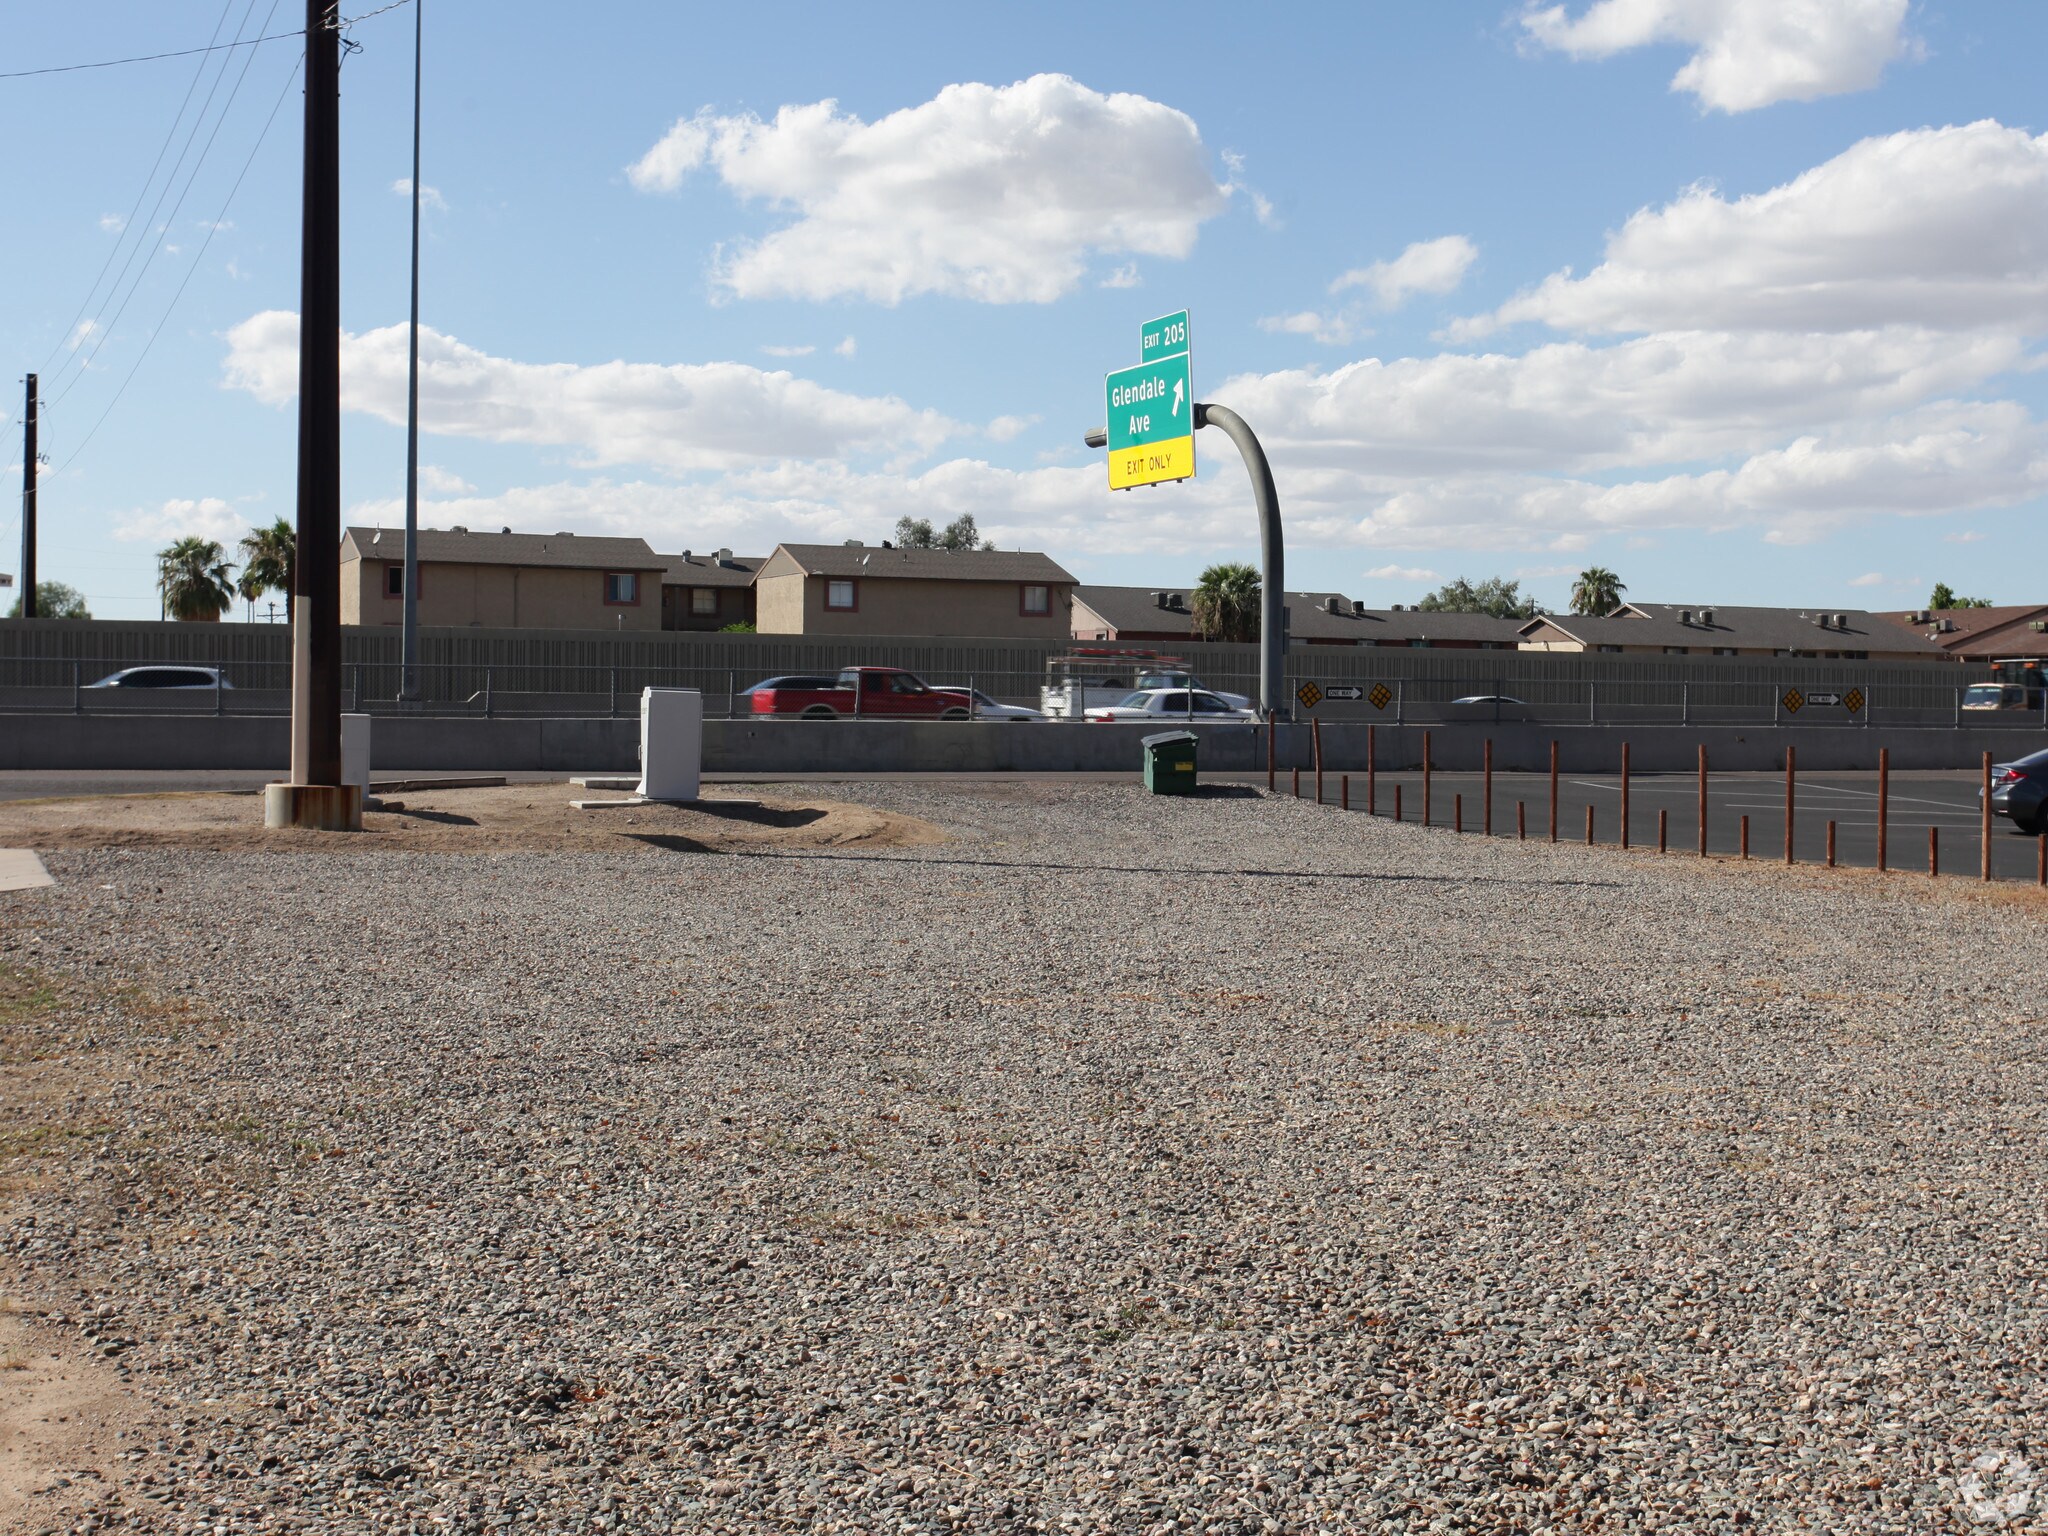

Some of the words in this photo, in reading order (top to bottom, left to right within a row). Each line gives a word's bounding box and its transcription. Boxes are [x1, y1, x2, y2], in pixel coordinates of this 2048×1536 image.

[1144, 332, 1160, 349] EXIT
[1164, 322, 1185, 346] 205
[1112, 376, 1165, 408] Glendale
[1129, 415, 1150, 435] Ave
[1127, 458, 1144, 475] EXIT
[1149, 453, 1172, 471] ONLY
